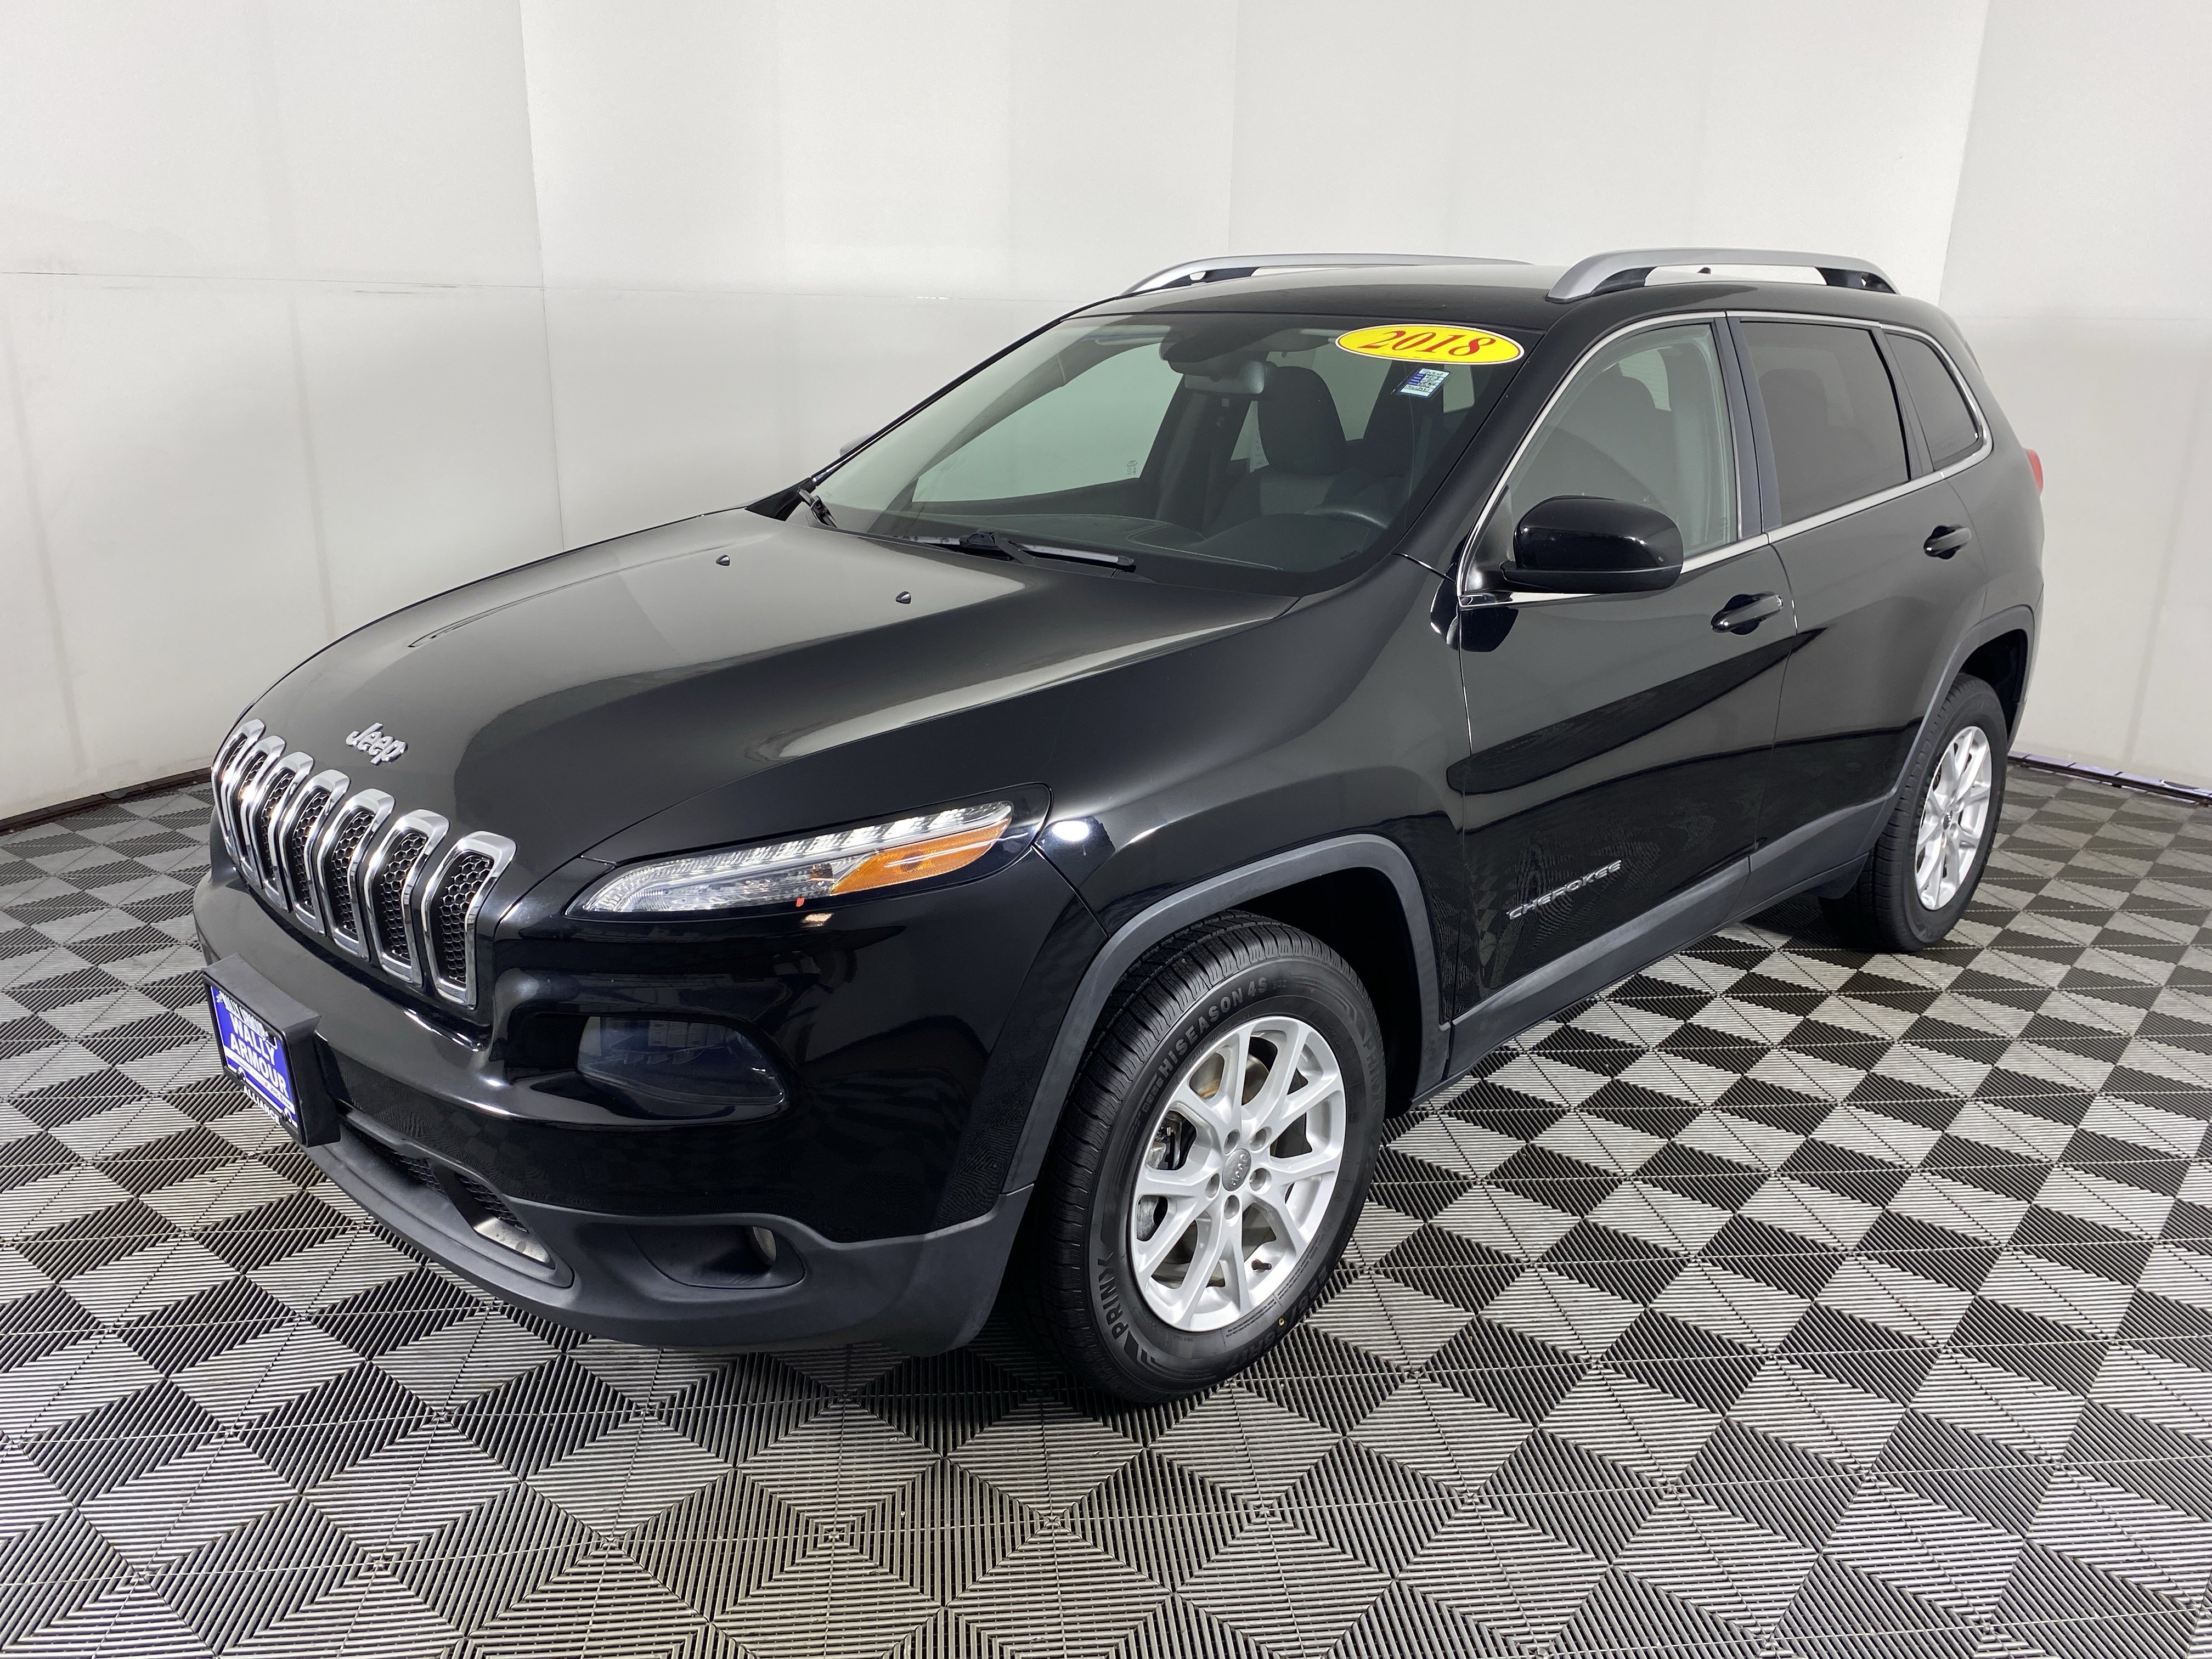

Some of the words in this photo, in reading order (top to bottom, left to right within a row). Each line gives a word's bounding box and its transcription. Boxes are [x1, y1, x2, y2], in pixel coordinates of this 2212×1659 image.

[1358, 330, 1496, 356] 2018
[346, 723, 407, 765] Jeep
[1506, 860, 1621, 920] CHEROKEE
[229, 1012, 276, 1065] WALLY
[1159, 988, 1243, 1078] HISEASON
[1248, 977, 1268, 997] 4S
[230, 1033, 290, 1098] ARMOUR
[243, 1086, 281, 1125] ALLIANCE
